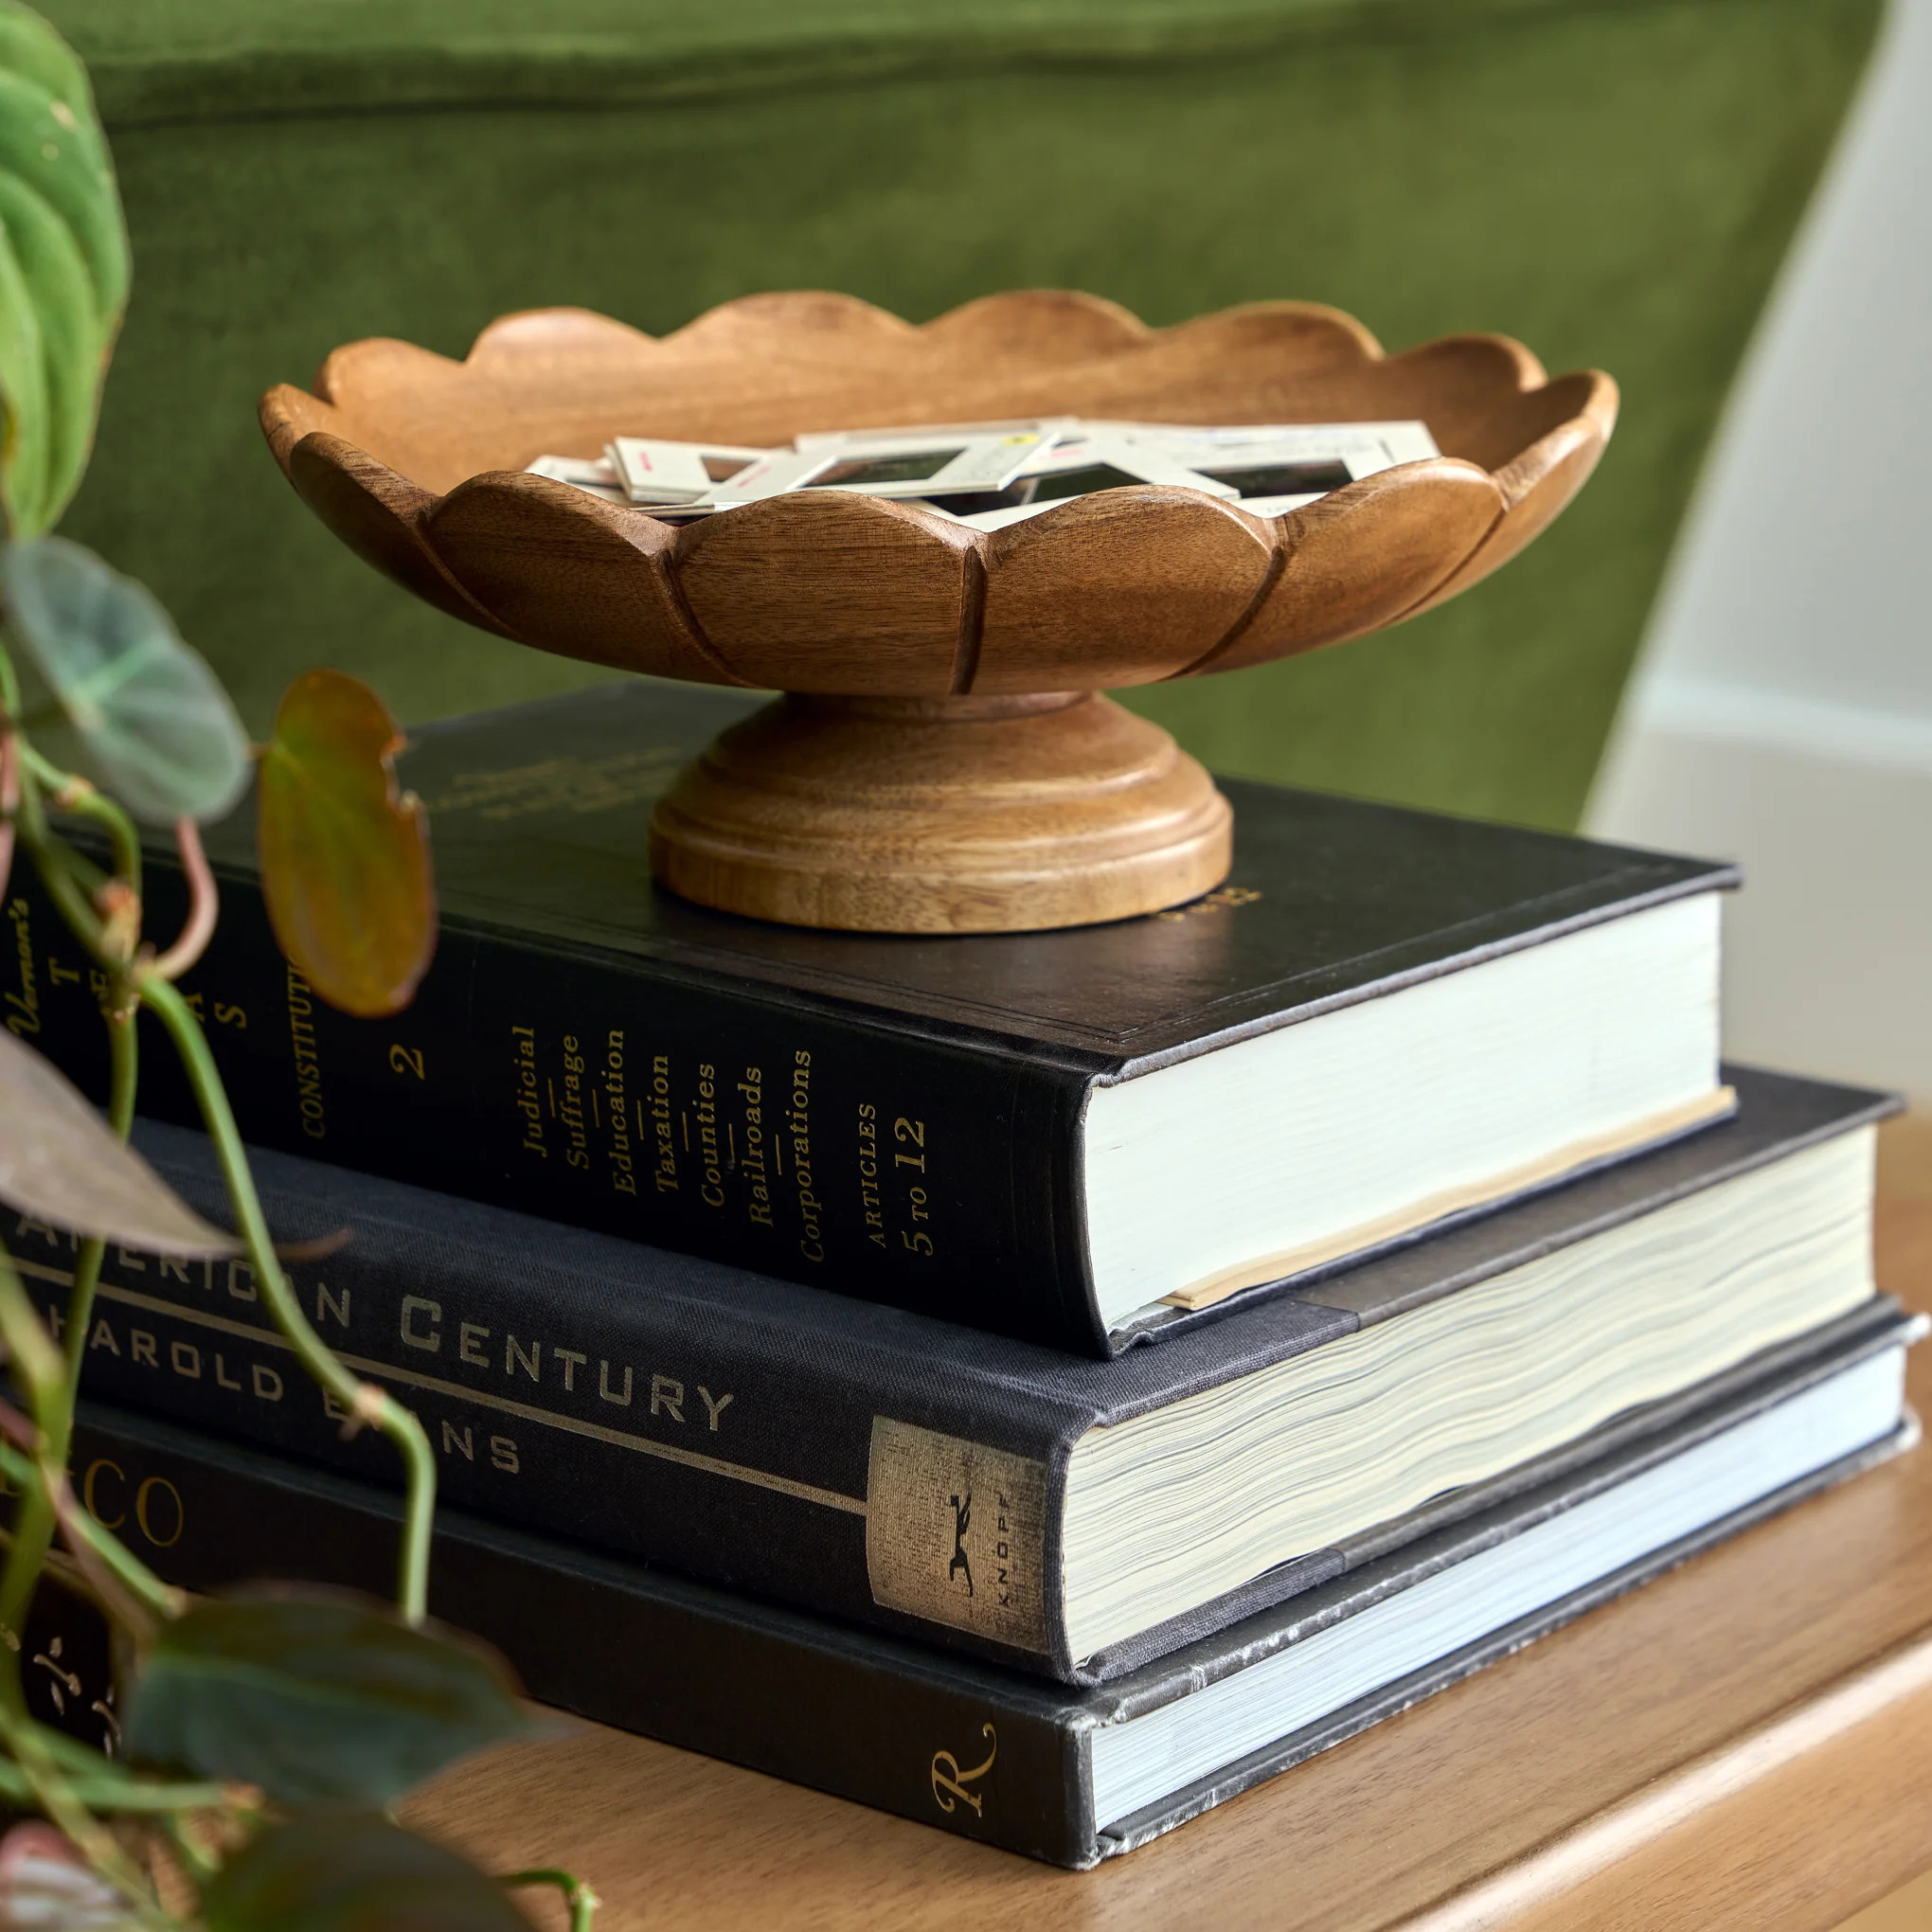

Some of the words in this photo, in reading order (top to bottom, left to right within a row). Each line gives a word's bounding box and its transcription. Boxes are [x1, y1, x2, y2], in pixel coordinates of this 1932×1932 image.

[288, 951, 327, 1138] CONSTITUTI
[389, 1044, 425, 1081] 2
[513, 1026, 547, 1157] Judicial
[557, 1034, 590, 1170] Suffrage
[600, 1029, 636, 1196] Education
[647, 1055, 680, 1192] Taxation
[692, 1063, 725, 1208] Counties
[737, 1065, 774, 1227] Railroads
[785, 1048, 825, 1263] Corporations
[858, 1102, 886, 1248] ARTICLES
[893, 1116, 926, 1175] 12
[900, 1230, 934, 1257] 5
[400, 1294, 734, 1431] CENTURY
[996, 1493, 1011, 1607] KNOPF
[931, 1722, 997, 1818] R
